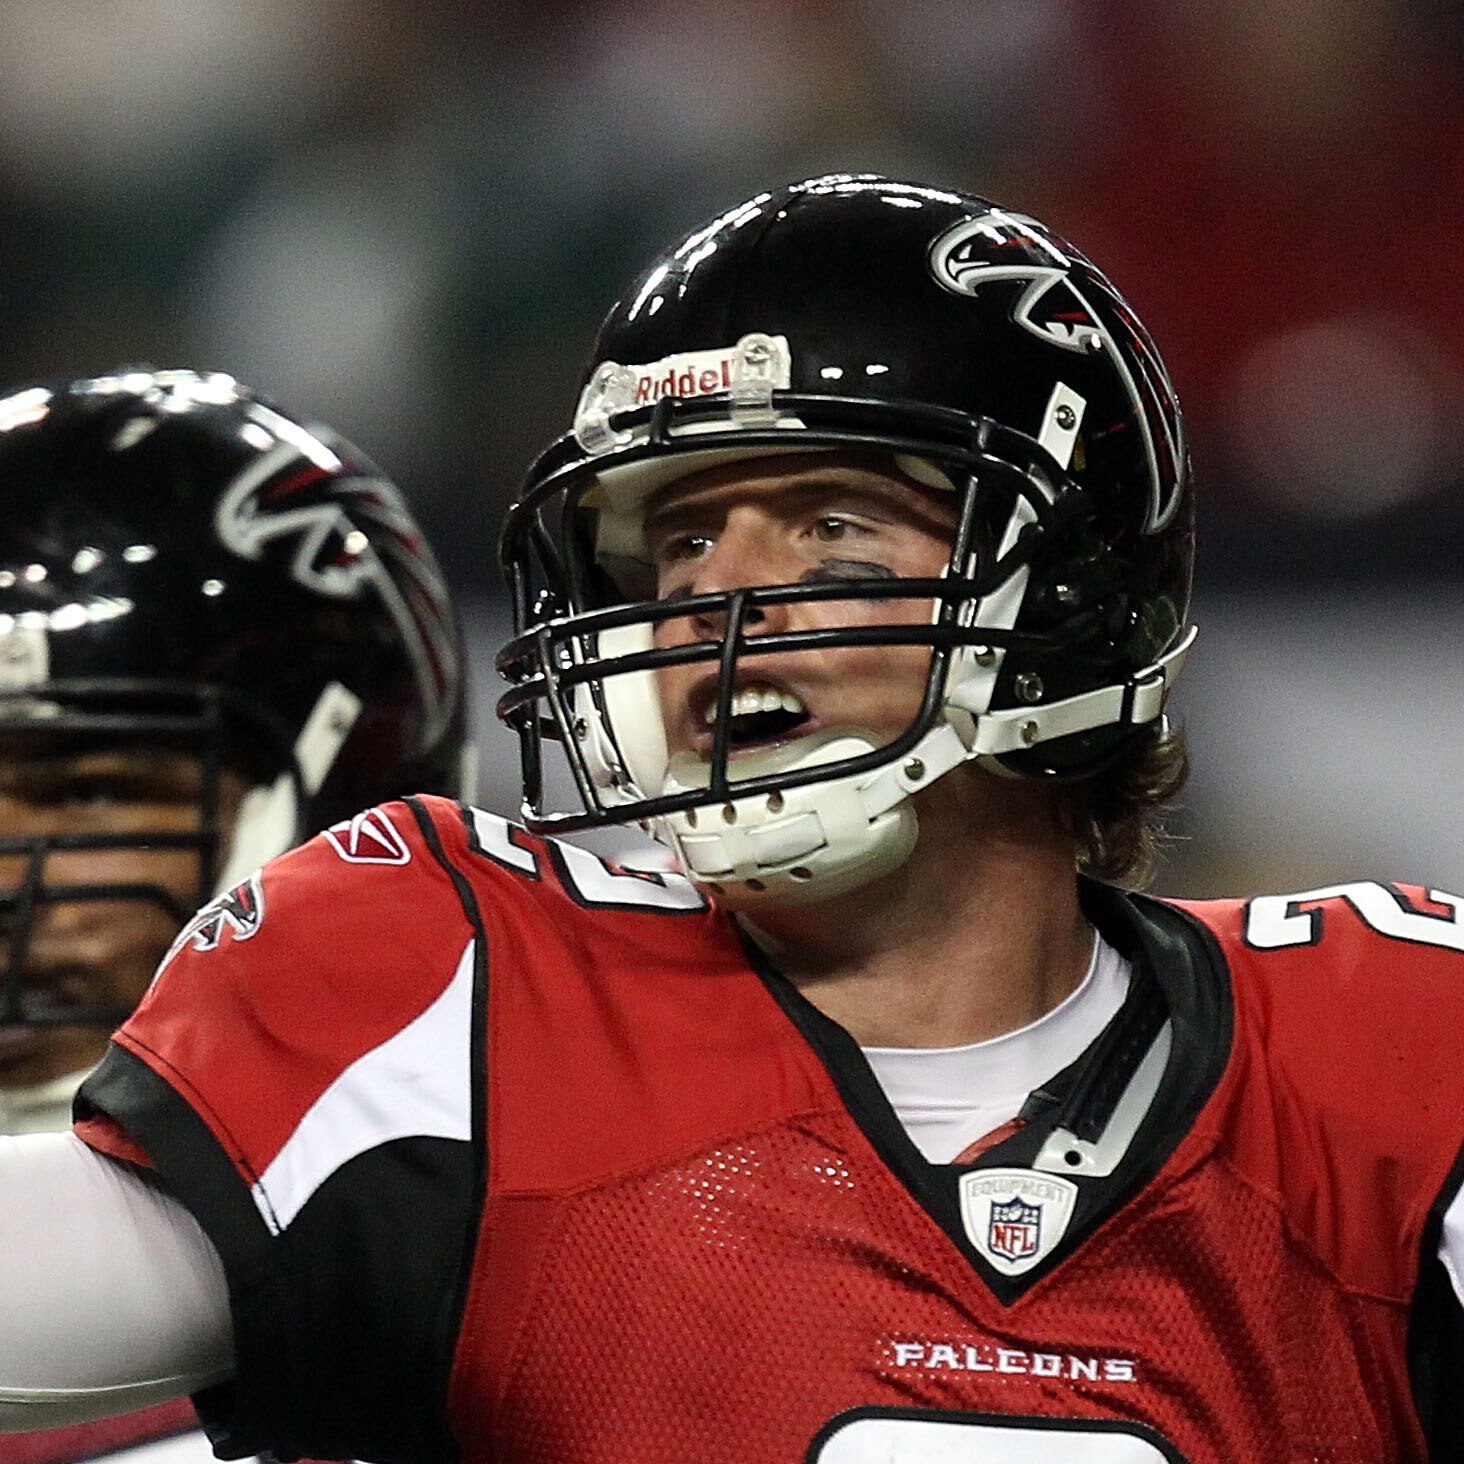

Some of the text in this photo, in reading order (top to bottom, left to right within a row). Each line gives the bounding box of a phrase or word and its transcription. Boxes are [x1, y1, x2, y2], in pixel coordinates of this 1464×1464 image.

[635, 359, 738, 404] Riddel
[990, 1222, 1037, 1255] NFL
[893, 1342, 1137, 1382] FALCONS
